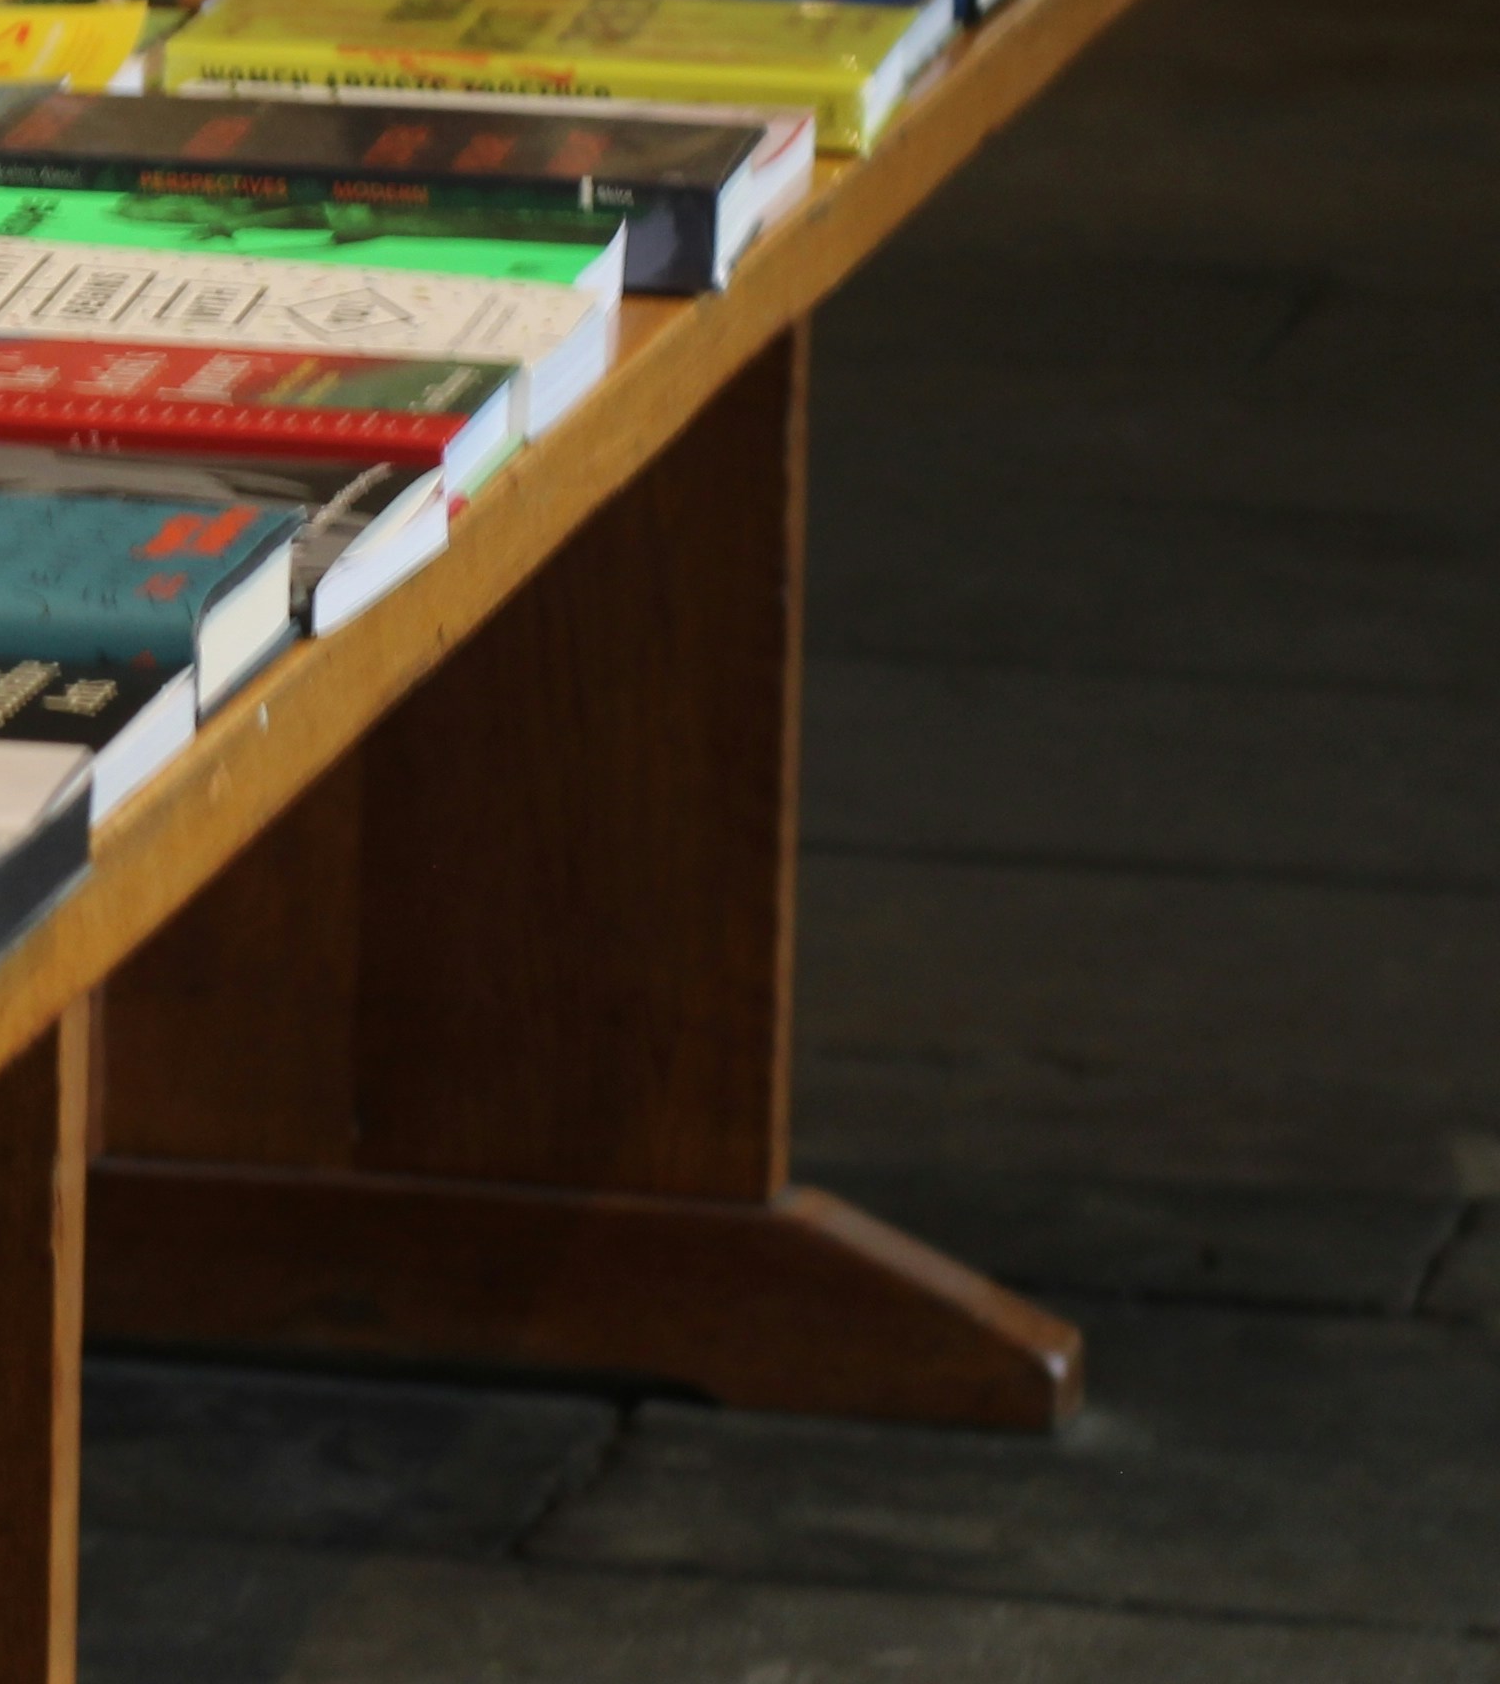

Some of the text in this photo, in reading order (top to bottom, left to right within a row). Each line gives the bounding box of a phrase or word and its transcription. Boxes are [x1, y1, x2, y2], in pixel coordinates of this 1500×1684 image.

[199, 65, 312, 88] WOMEN
[325, 70, 447, 94] ARTISTS
[138, 171, 290, 198] PERSPECTIVES
[331, 180, 430, 205] MODERN
